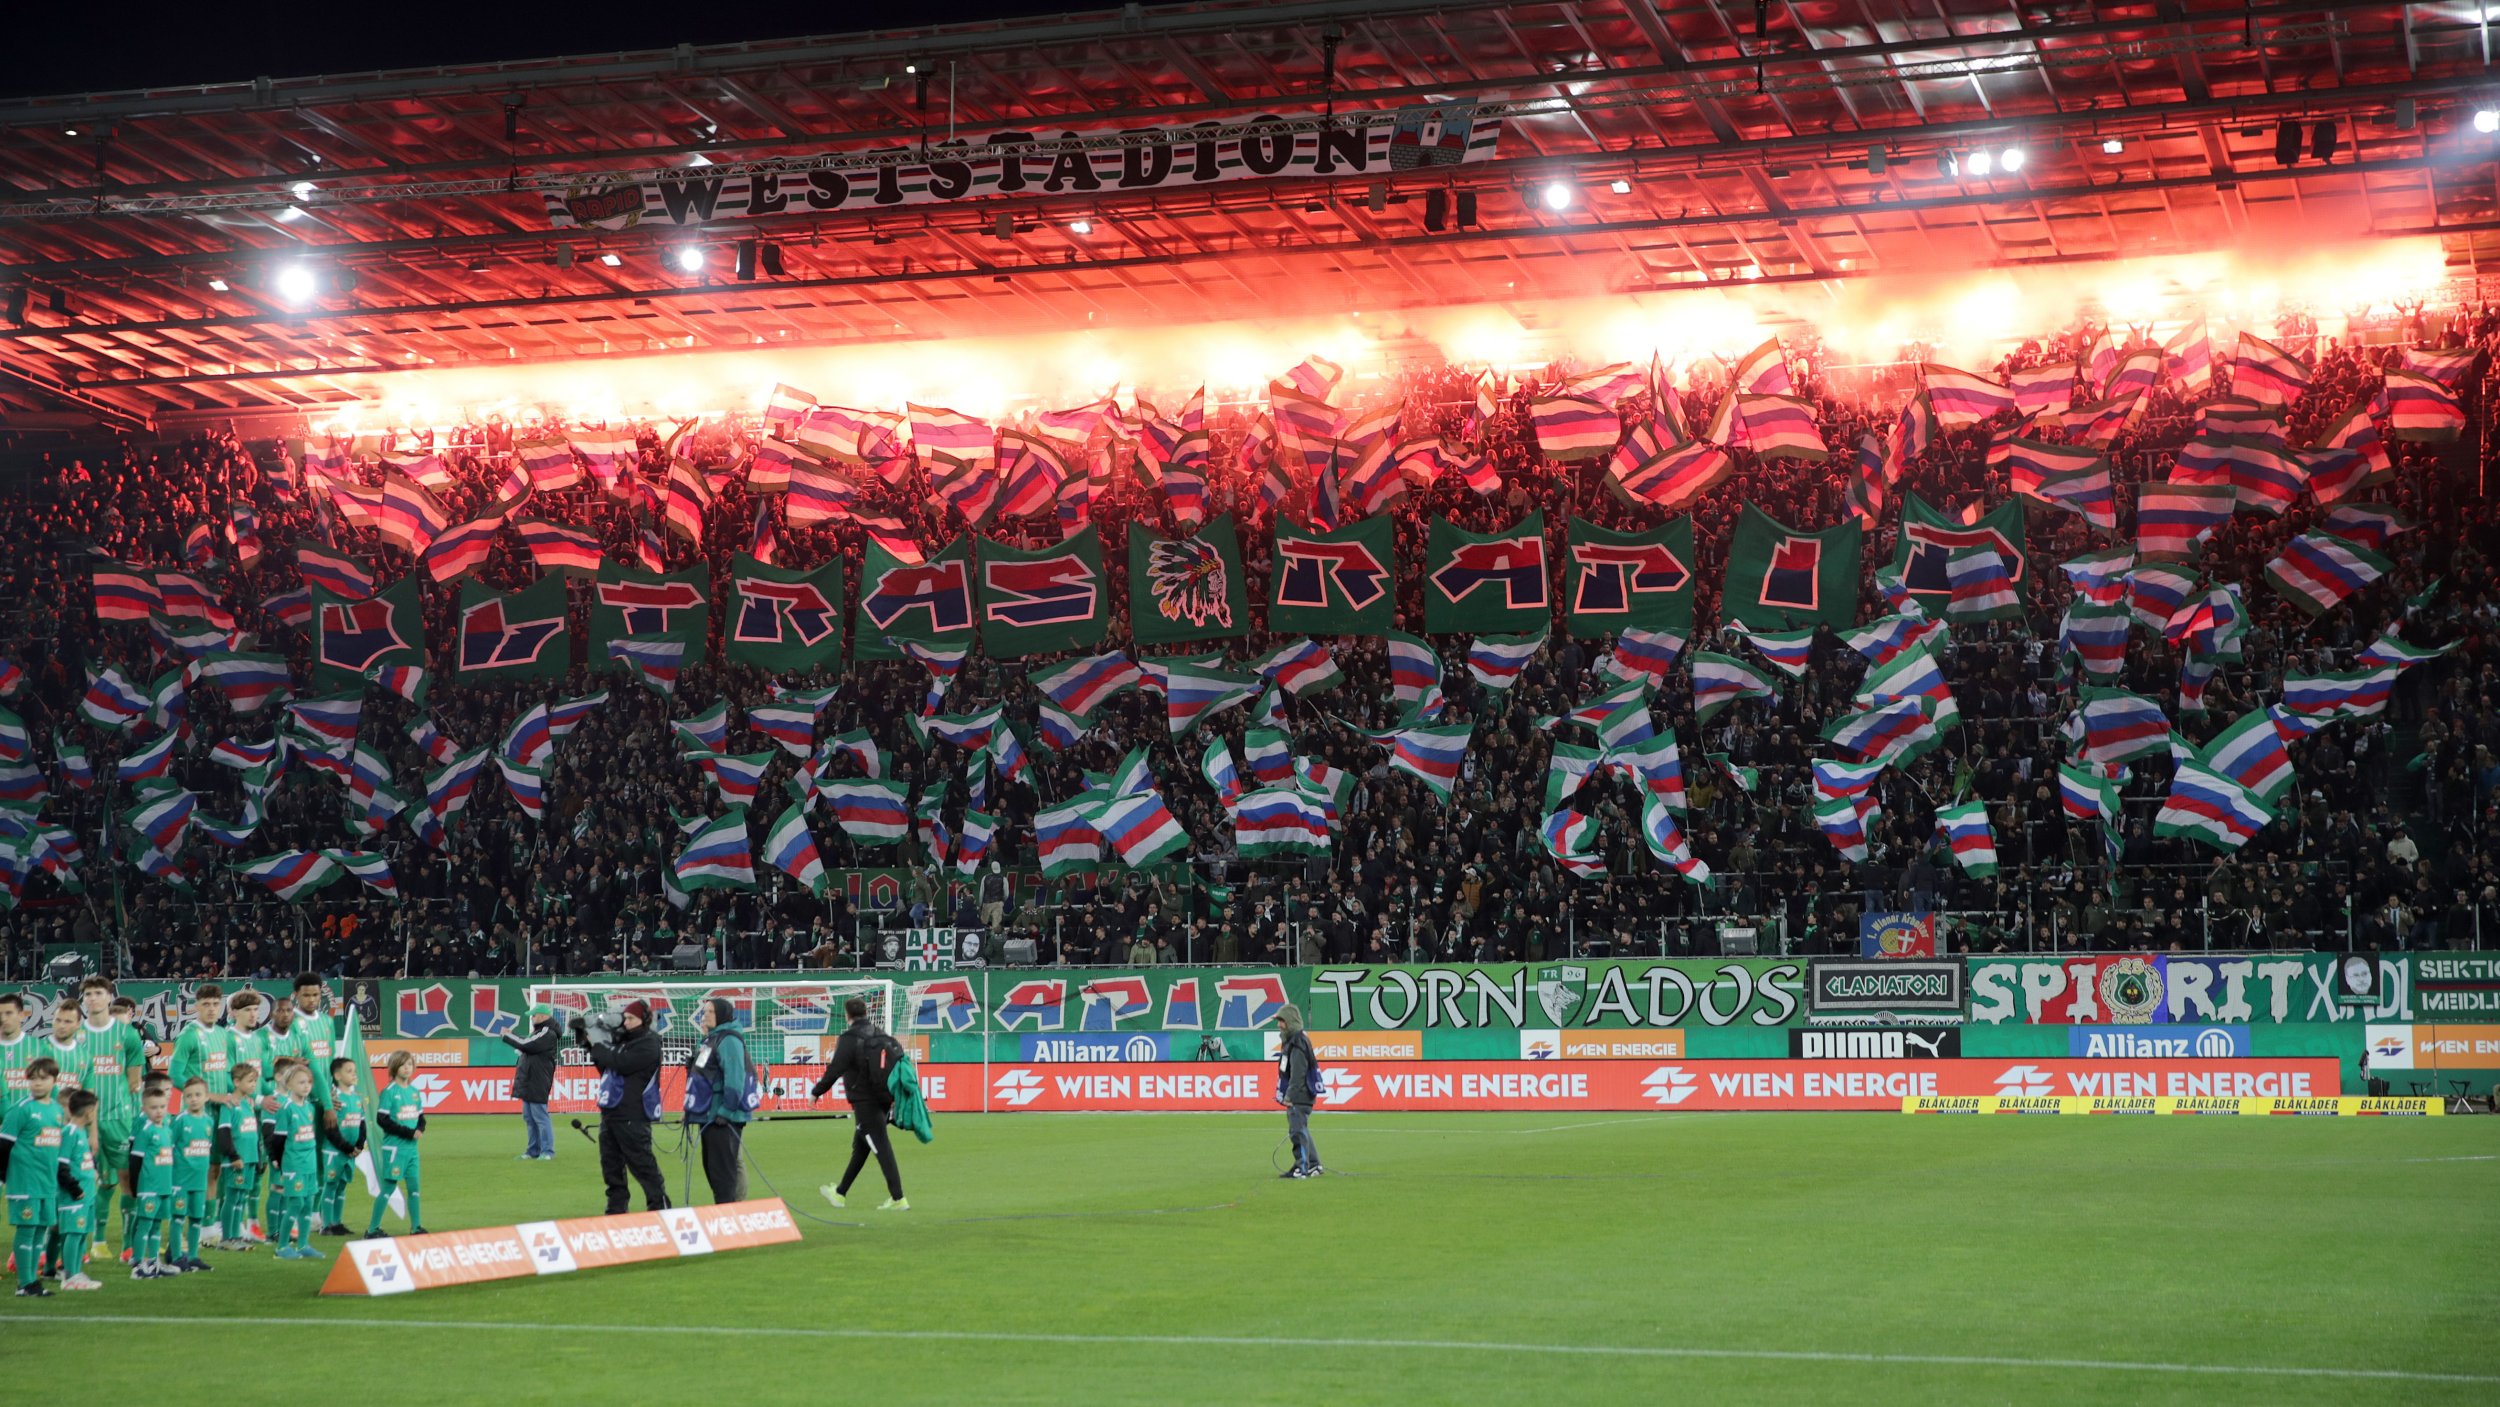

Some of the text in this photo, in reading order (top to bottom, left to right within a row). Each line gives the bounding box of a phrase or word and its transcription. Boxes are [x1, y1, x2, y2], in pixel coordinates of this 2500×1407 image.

[657, 113, 1370, 224] WESTSTADION
[571, 188, 640, 222] RAPID
[1542, 970, 1558, 979] TR
[1826, 975, 1947, 997] GLADIATORI
[913, 975, 1289, 1032] RAPID
[2422, 992, 2500, 1010] MEIDLI
[1034, 1040, 1119, 1061] Allianz
[1353, 1045, 1414, 1057] ENERGIE
[1566, 1043, 1677, 1056] WIEN ENERGIE
[1802, 1032, 1904, 1058] PUMA
[2086, 1034, 2188, 1057] Allianz
[2420, 1041, 2469, 1053] WIEN
[93, 1056, 114, 1064] IEN
[461, 1079, 512, 1101] WIE
[1055, 1075, 1131, 1098] WIEN
[1139, 1075, 1259, 1098] ENERGIE
[1374, 1074, 1588, 1098] WIEN ENERGIE
[1710, 1073, 1937, 1097] WIEN ENERGIE
[2066, 1072, 2311, 1096] WIEN ENERGIE
[705, 1209, 790, 1237] WIEN ENERGIE
[568, 1225, 668, 1253] WIEN ENERGIE
[408, 1240, 523, 1271] WIEN ENERGIE
